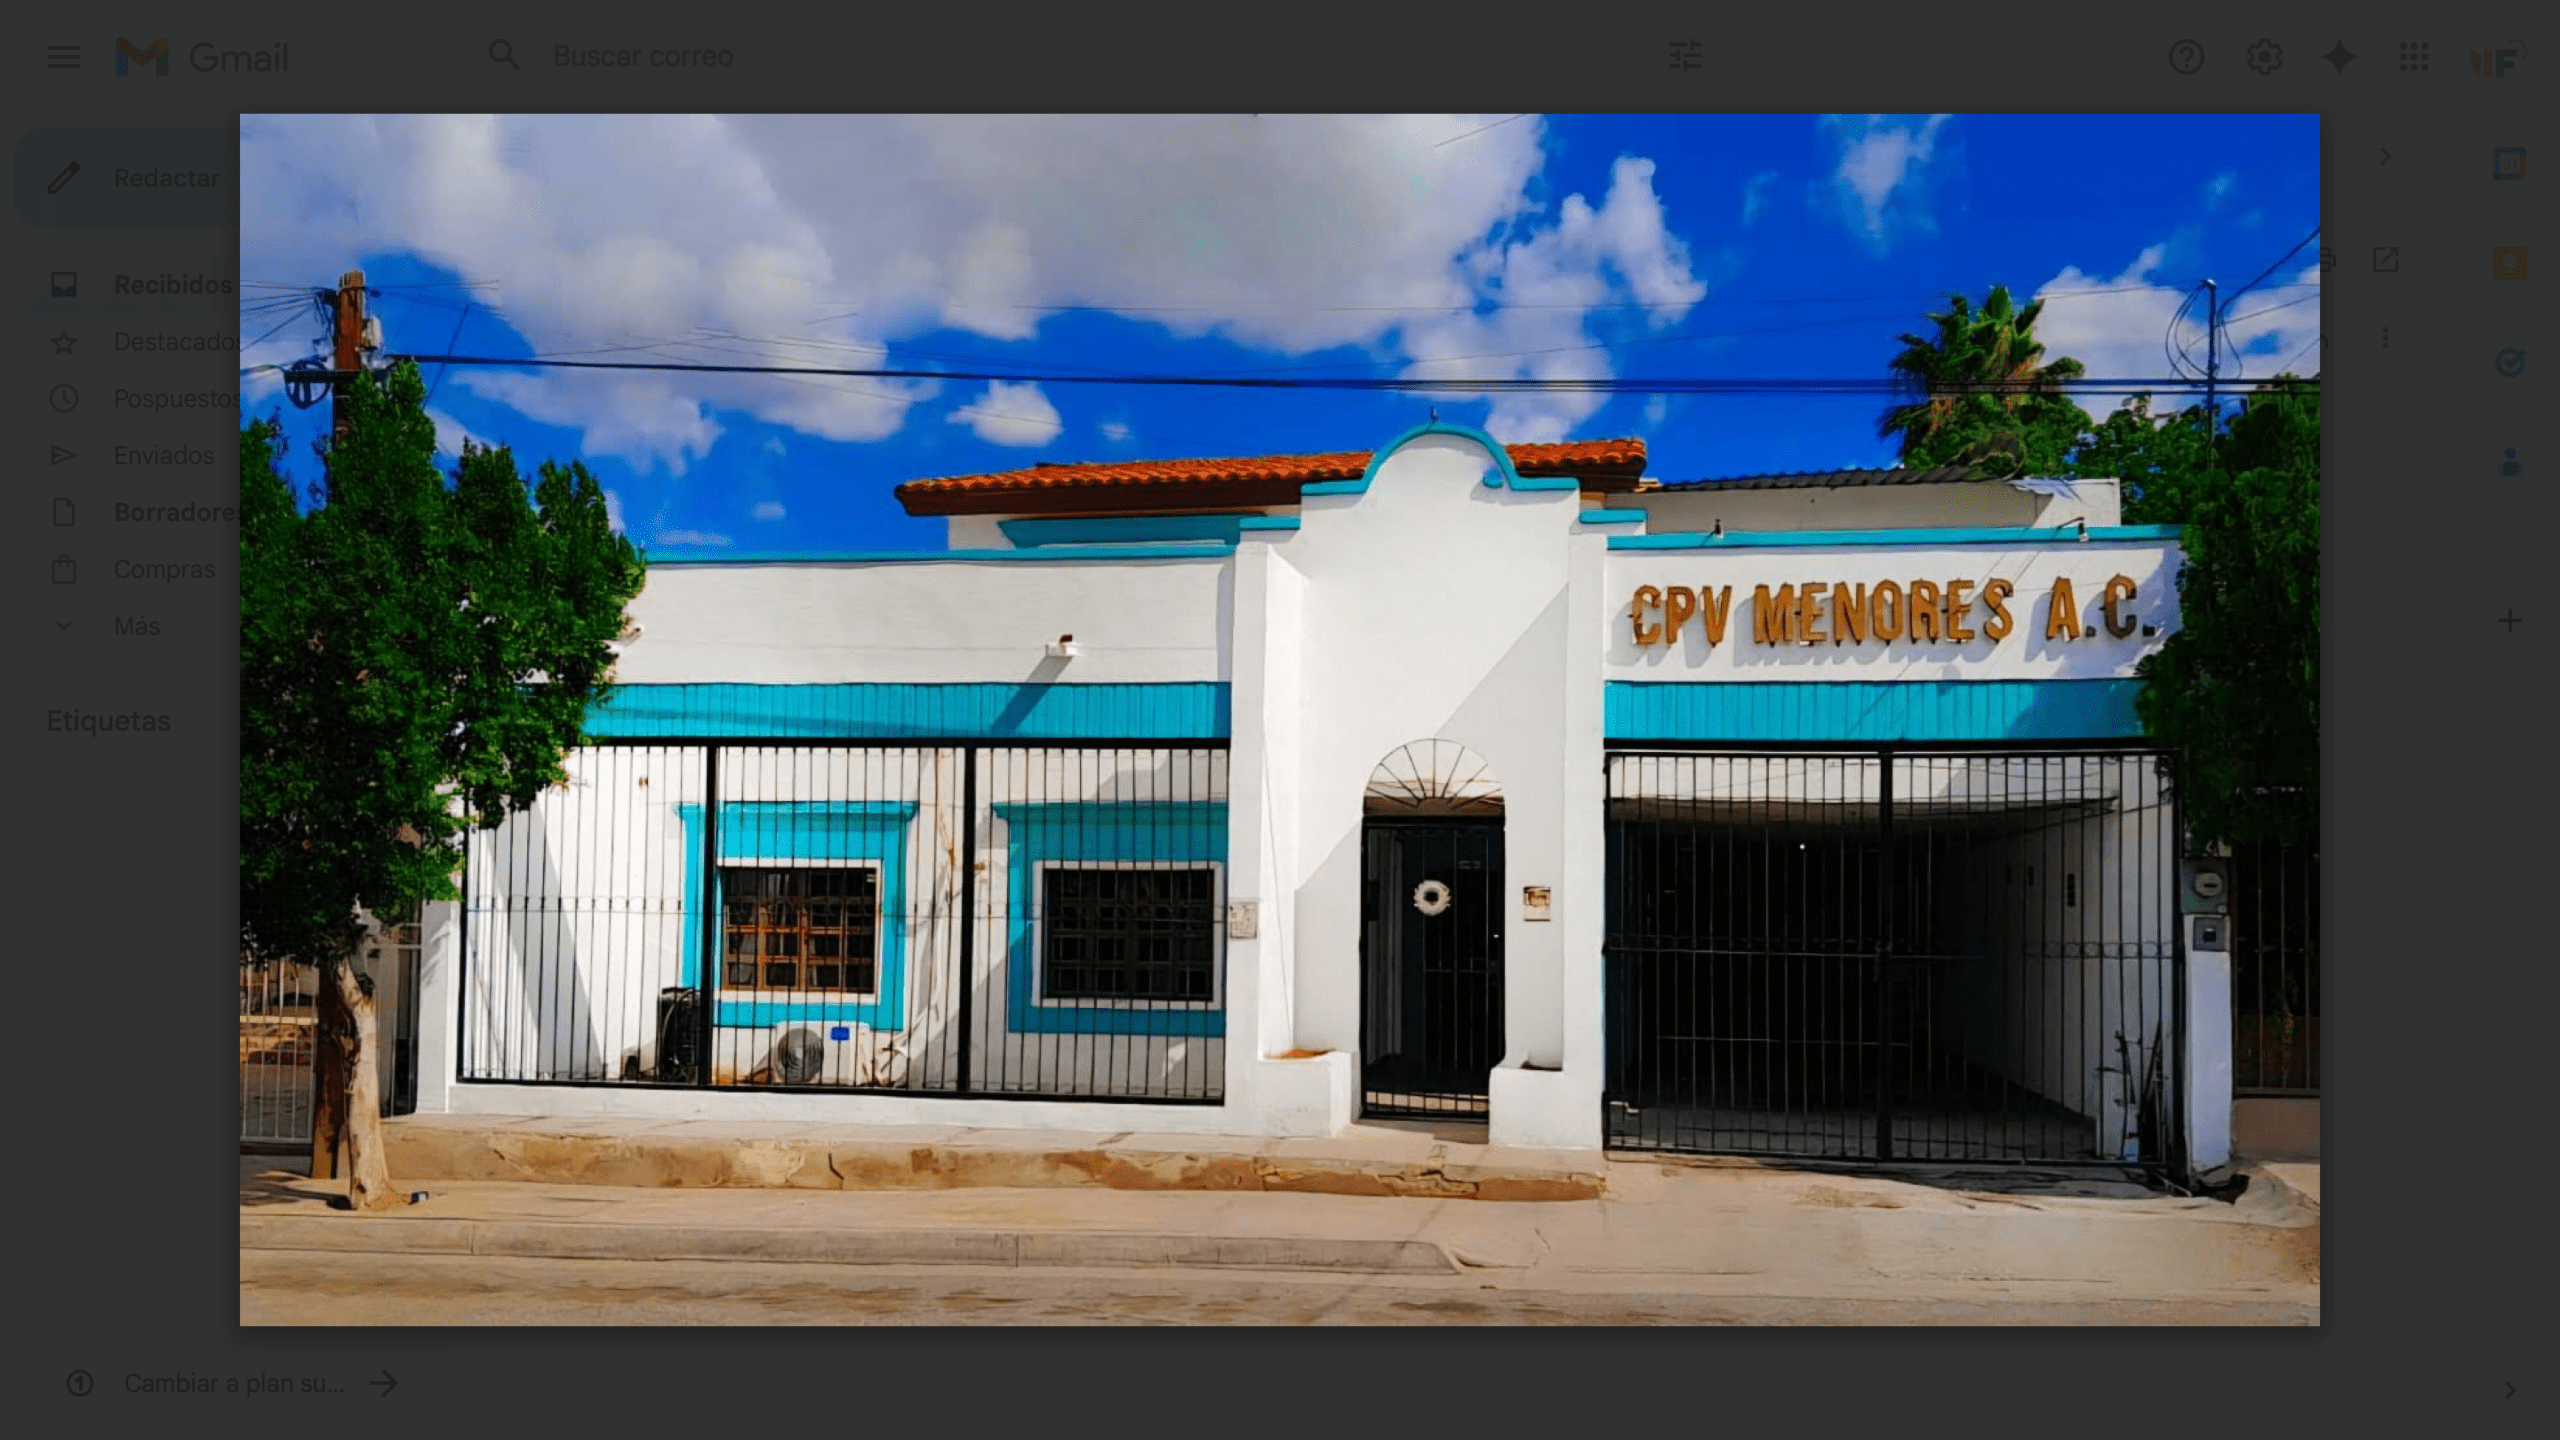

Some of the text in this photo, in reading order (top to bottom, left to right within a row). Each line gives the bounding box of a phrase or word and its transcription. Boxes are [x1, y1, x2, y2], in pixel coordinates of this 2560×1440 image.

[189, 41, 288, 73] Gmail
[554, 44, 734, 68] Buscar correo
[2503, 157, 2518, 171] 31
[114, 166, 221, 190] Redactar
[114, 273, 233, 295] Recibidos
[114, 444, 215, 466] Enviados
[114, 558, 216, 584] Compras
[1632, 574, 2156, 648] CPV MENORES A.C.
[114, 614, 161, 636] Más
[47, 708, 172, 738] Etiquetas
[124, 1371, 345, 1399] Cambiar a plan su...
